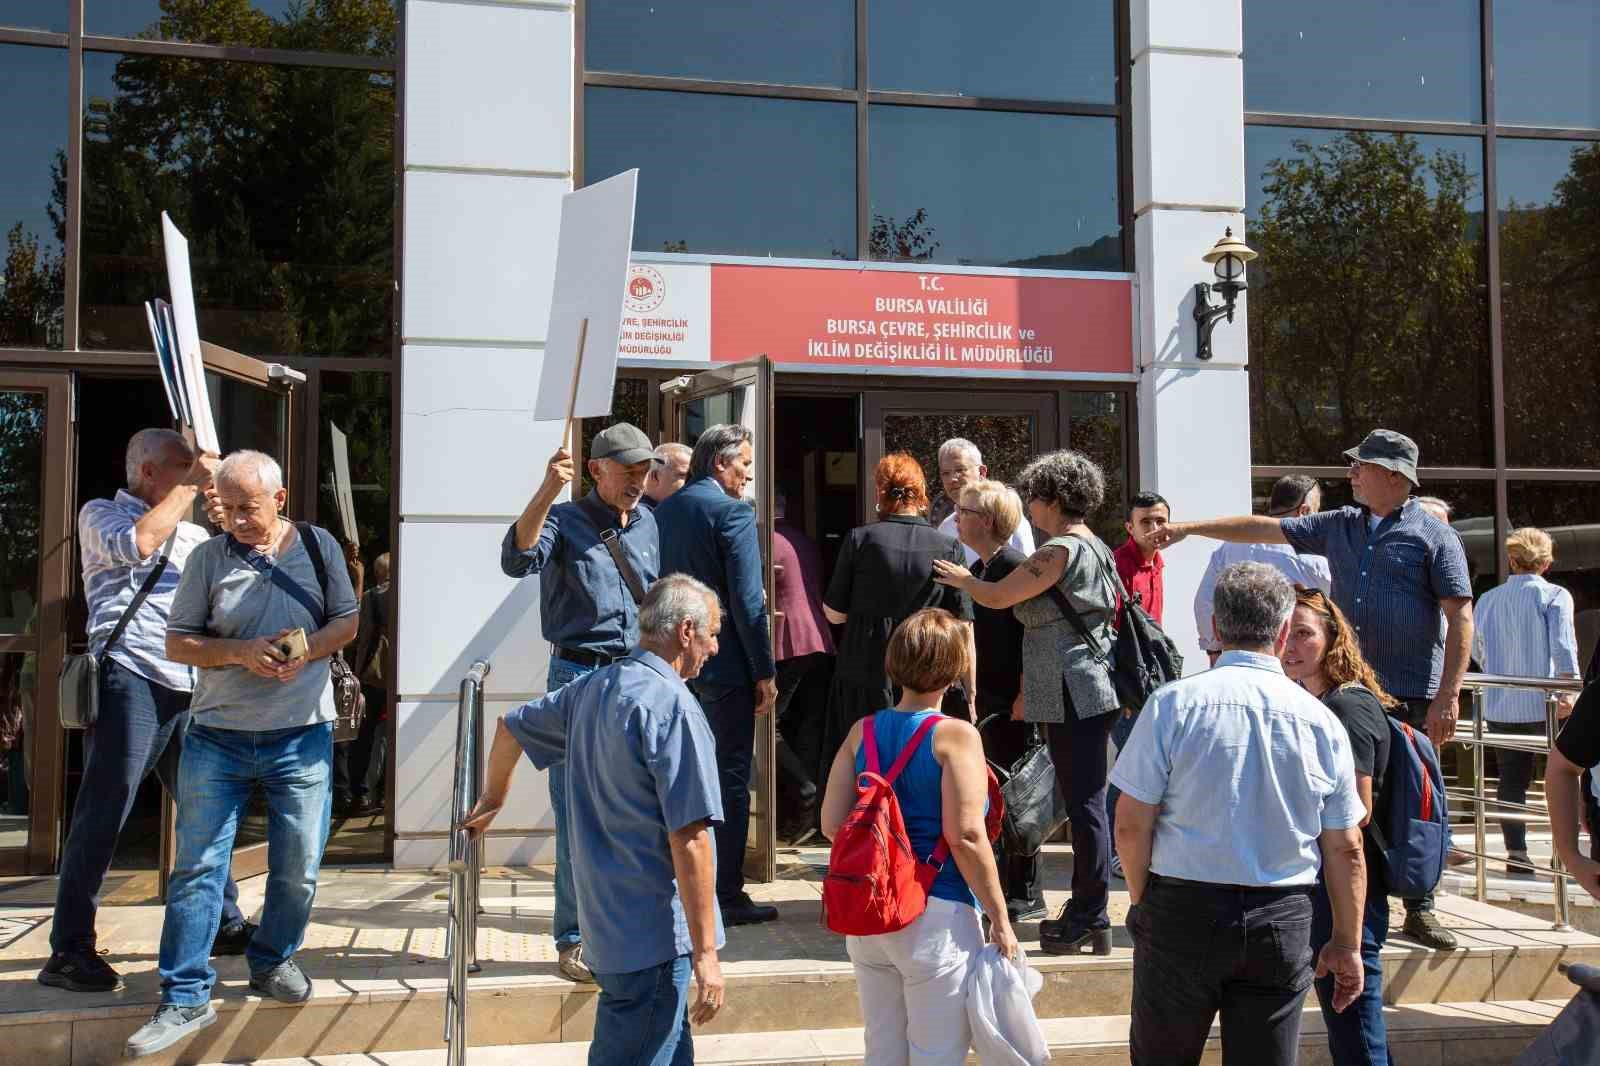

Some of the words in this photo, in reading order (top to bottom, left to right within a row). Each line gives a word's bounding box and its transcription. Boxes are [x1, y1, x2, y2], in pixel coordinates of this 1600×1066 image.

[918, 275, 945, 292] T.C.
[875, 297, 925, 315] BURSA
[927, 298, 988, 316] VALİLİĞİ
[827, 319, 877, 335] BURSA
[879, 321, 930, 339] ÇEVRE,
[933, 321, 1013, 341] ŞEHİRCİLİK
[1018, 329, 1036, 341] ve
[808, 339, 850, 357] İKLİM
[854, 342, 941, 363] DEĞİŞİKLİĞİ
[945, 344, 958, 361] İL
[961, 344, 1053, 364] MÜDÜRLÜĞÜ
